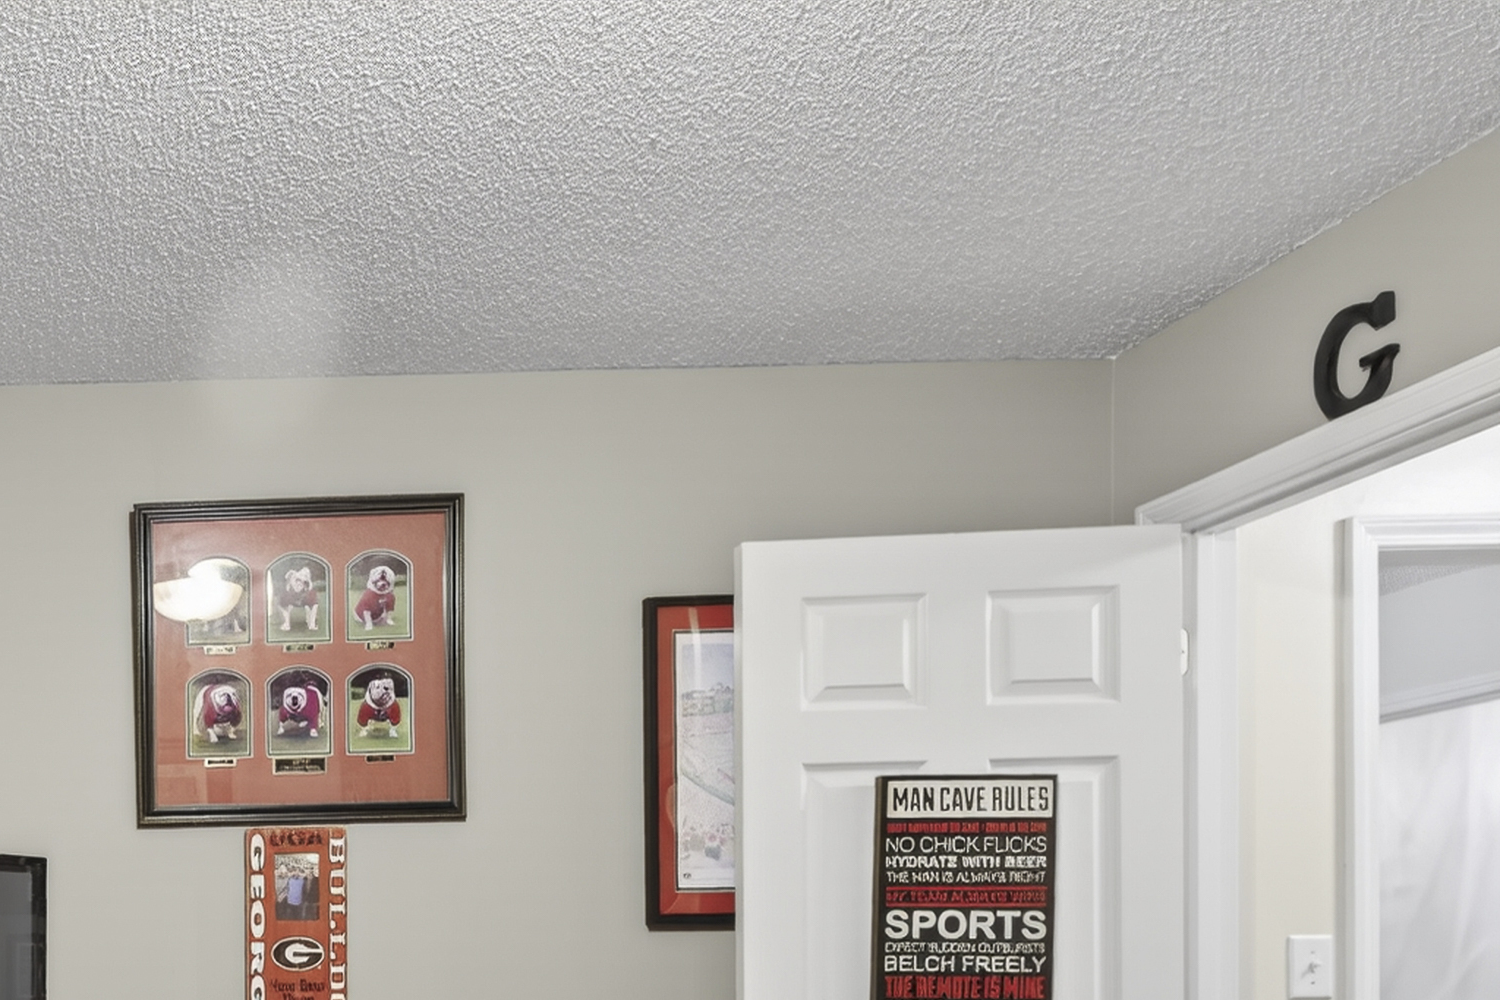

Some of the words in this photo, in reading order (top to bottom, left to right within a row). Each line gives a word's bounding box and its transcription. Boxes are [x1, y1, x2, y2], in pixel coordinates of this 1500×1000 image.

[1313, 290, 1400, 421] G
[892, 787, 935, 812] MAN
[940, 787, 988, 812] CAVE
[992, 786, 1049, 812] RULES
[885, 836, 915, 853] NO
[919, 836, 981, 853] CHICK
[983, 836, 1048, 853] FLICKS
[885, 856, 958, 868] HYDRATE
[961, 856, 1001, 868] WITH
[1004, 856, 1048, 868] BEER
[886, 871, 910, 883] THE
[884, 909, 1047, 940] SPORTS
[884, 955, 956, 972] BELCH
[961, 955, 1047, 973] FREELY
[885, 976, 913, 998] THE
[915, 976, 983, 999] REMOTE
[984, 976, 1001, 999] IS
[1003, 977, 1046, 999] MINE
